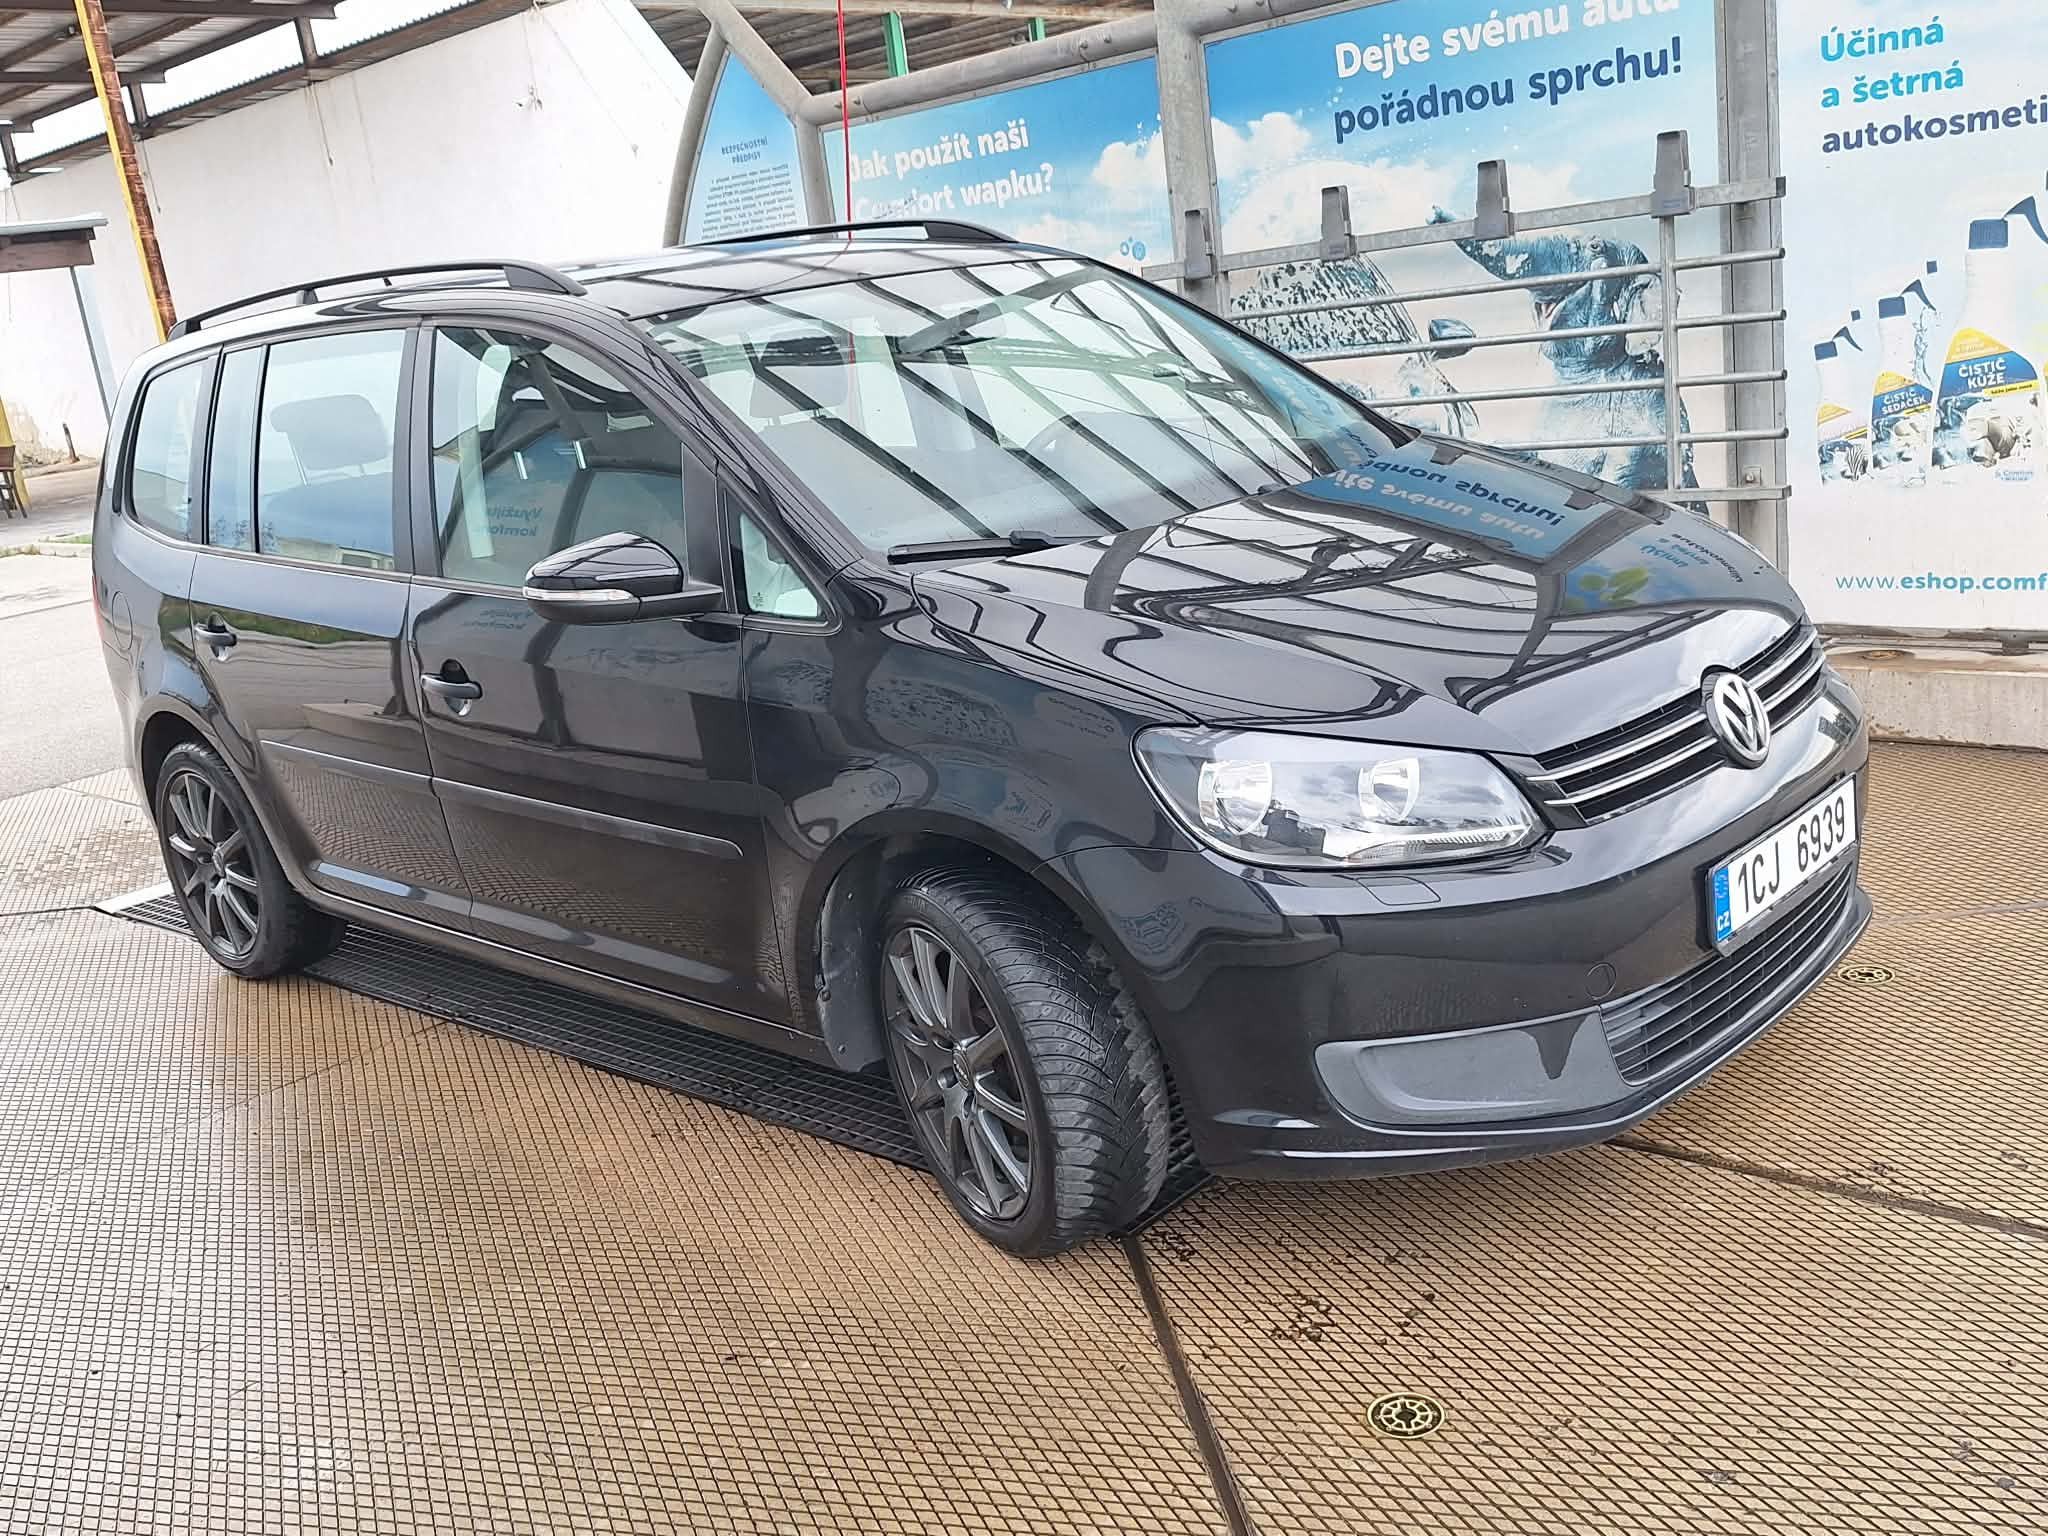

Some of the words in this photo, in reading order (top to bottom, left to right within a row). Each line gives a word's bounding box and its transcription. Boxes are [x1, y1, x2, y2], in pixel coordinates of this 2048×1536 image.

[1334, 32, 1431, 80] Dejte
[1442, 2, 1569, 57] svému
[1820, 15, 1945, 62] Účinná
[1333, 78, 1514, 145] pořádnou
[1528, 36, 1682, 106] sprchu!
[1820, 87, 1840, 109] a
[1852, 59, 1964, 104] šetrná
[849, 150, 891, 183] Jak
[894, 131, 973, 180] použít
[977, 117, 1030, 157] naši
[960, 162, 1054, 208] wapku?
[1957, 357, 2008, 378] ČISTIČ
[1737, 840, 1781, 913] 1CJ
[1796, 794, 1846, 874] 6939
[1716, 910, 1731, 932] CZ
